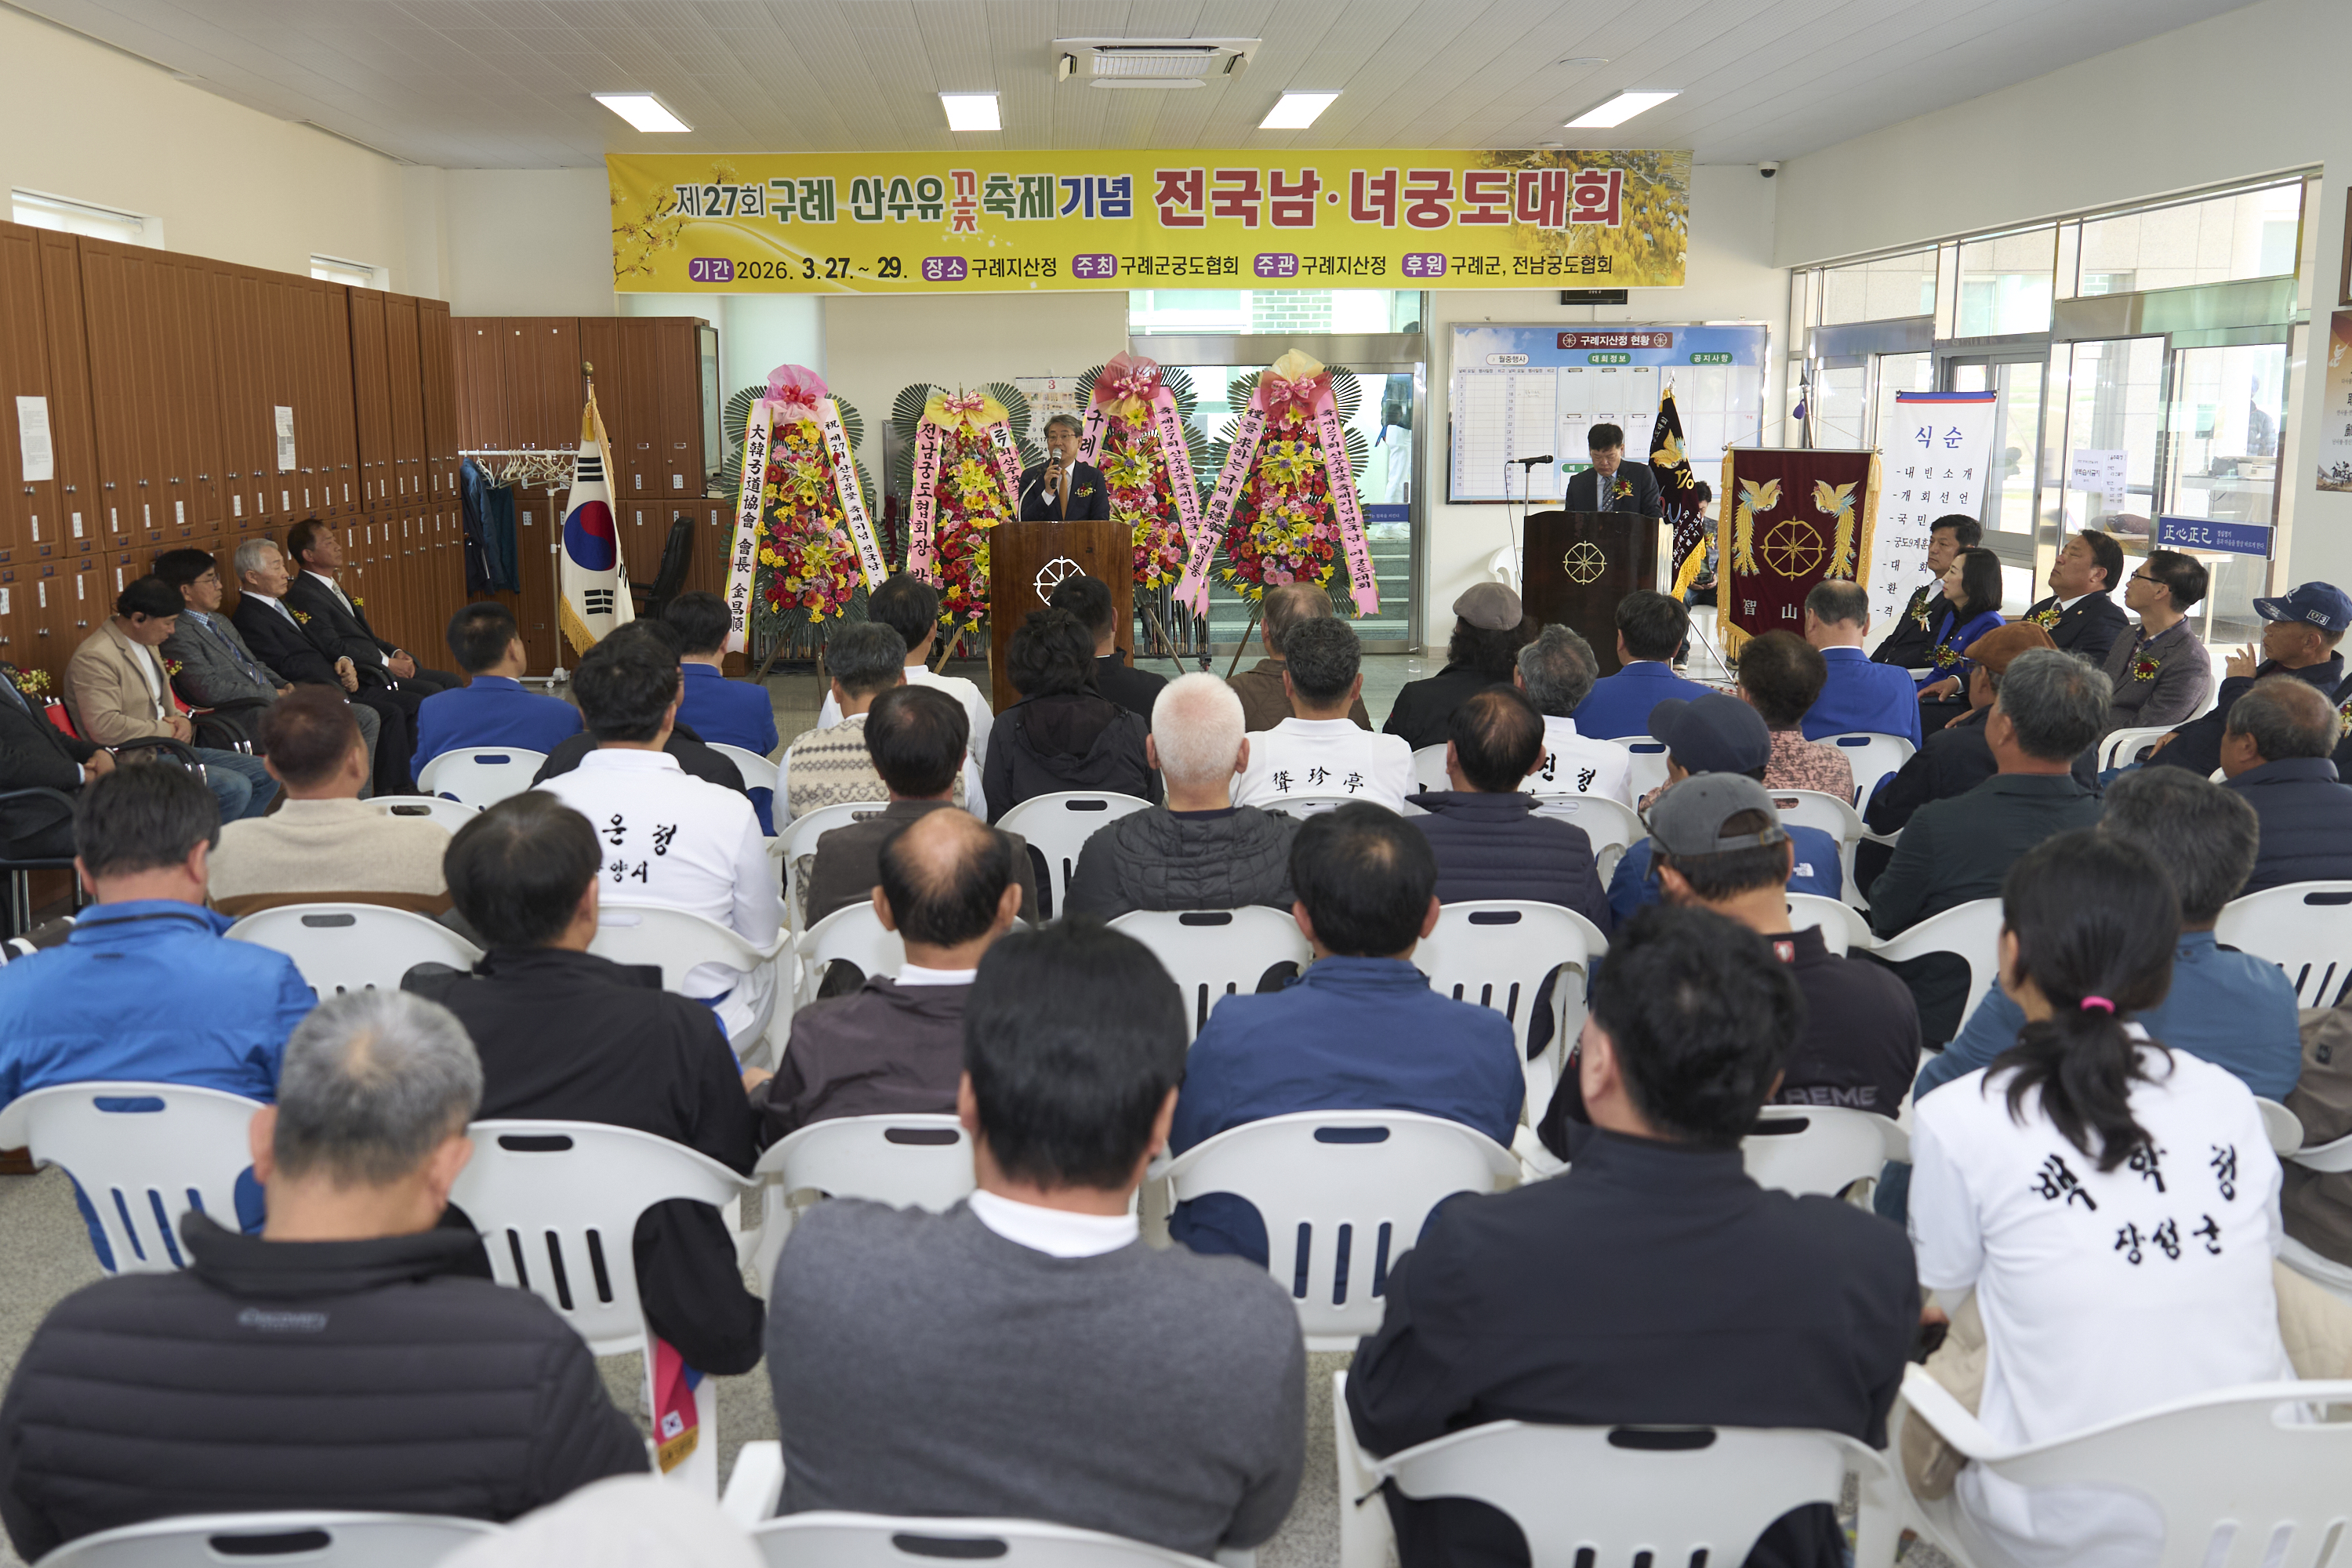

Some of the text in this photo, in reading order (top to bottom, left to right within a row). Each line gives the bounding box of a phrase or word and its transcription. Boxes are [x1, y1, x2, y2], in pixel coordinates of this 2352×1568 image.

[694, 260, 729, 280] 기간
[737, 261, 793, 280] 2026.
[926, 259, 964, 278] 장소
[971, 257, 1056, 278] 구례지산정
[1076, 256, 1113, 275] 주최
[1120, 256, 1239, 277] 구례군궁도협회
[1258, 256, 1294, 274] 주관
[1301, 255, 1386, 275] 구례지산정
[1406, 255, 1443, 274] 후원
[1450, 255, 1507, 276] 구례군,
[1513, 254, 1612, 274] 전남궁도협회
[1581, 336, 1650, 346] 구례지산정 현황
[1592, 354, 1627, 363] 대회정보
[1048, 379, 1055, 390] 3
[824, 419, 840, 430] 祝
[912, 423, 937, 557] 전남궁도협회장
[597, 859, 648, 883] 양시
